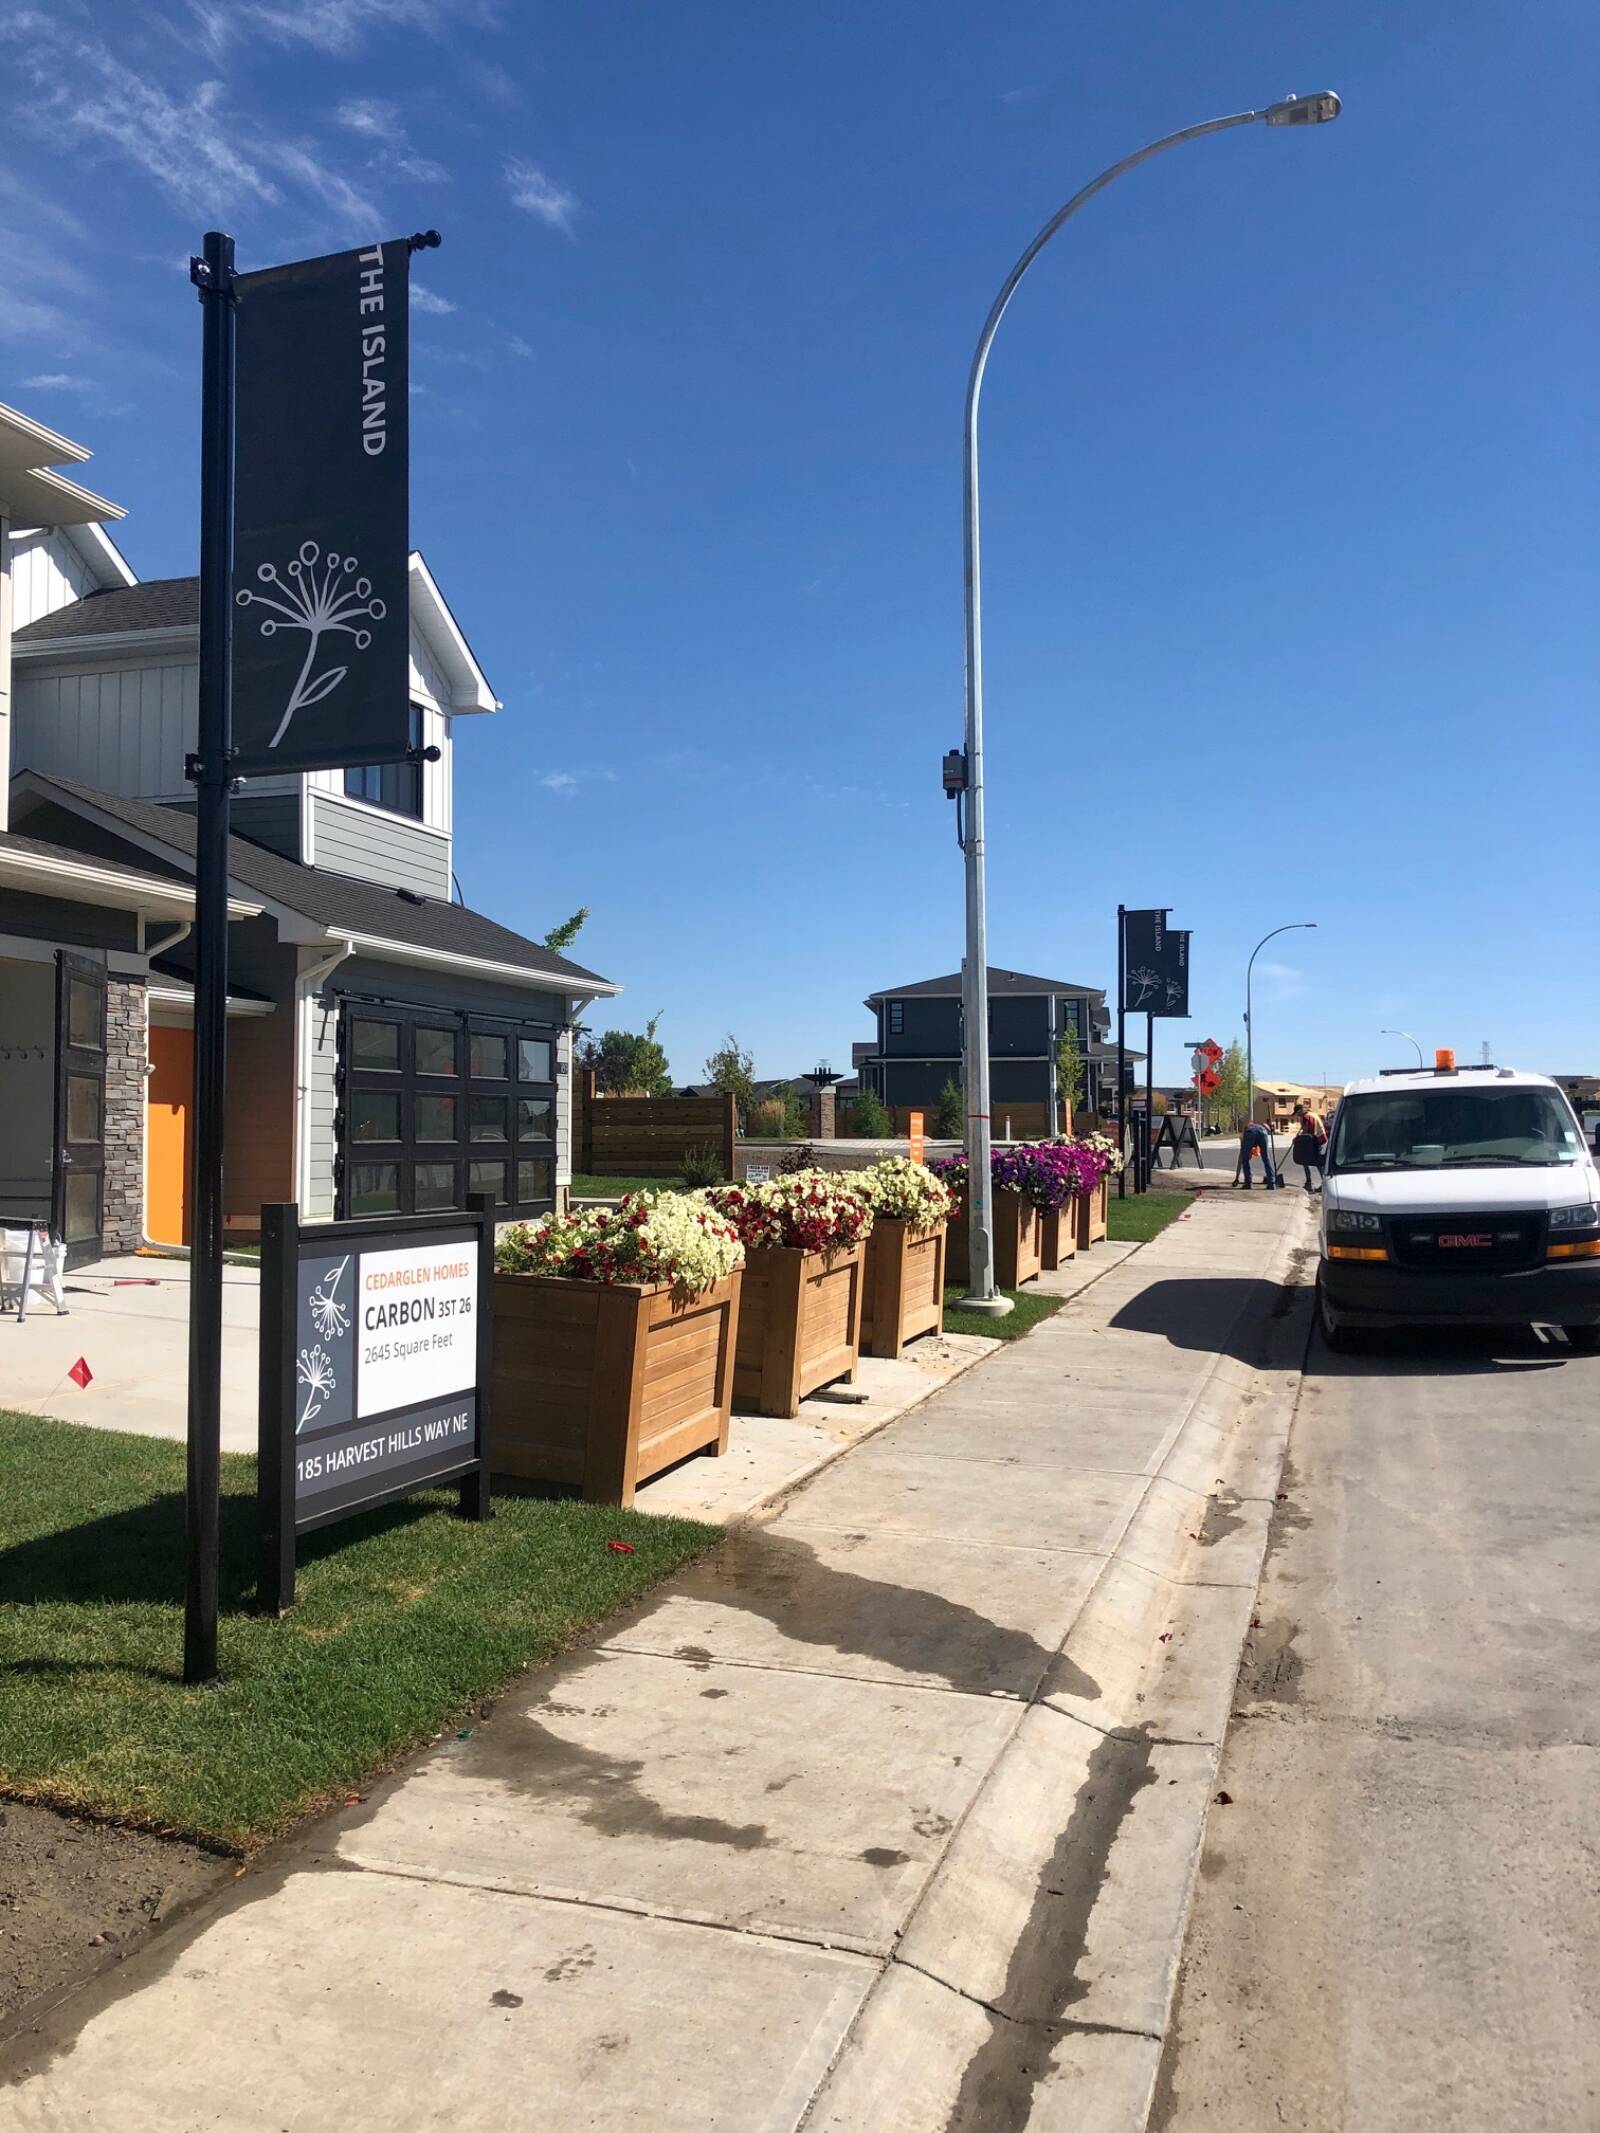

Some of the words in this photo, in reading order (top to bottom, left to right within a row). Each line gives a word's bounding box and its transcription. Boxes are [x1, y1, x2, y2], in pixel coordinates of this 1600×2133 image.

[359, 244, 384, 314] THE
[361, 324, 386, 456] ISLAND
[1154, 925, 1162, 952] ISLAND
[1438, 1234, 1492, 1247] GMC
[365, 1267, 431, 1291] CEDARGLEN
[433, 1262, 470, 1281] HOMES
[365, 1296, 435, 1331] CARBON
[438, 1299, 457, 1318] 3ST
[459, 1297, 472, 1315] 26
[364, 1343, 391, 1365] 2645
[393, 1339, 430, 1361] Square
[432, 1333, 453, 1350] Feet
[297, 1456, 323, 1482] 185
[326, 1437, 386, 1474] HARVEST
[388, 1426, 422, 1454] HILLS
[424, 1417, 451, 1442] WAY
[453, 1412, 469, 1434] NE
